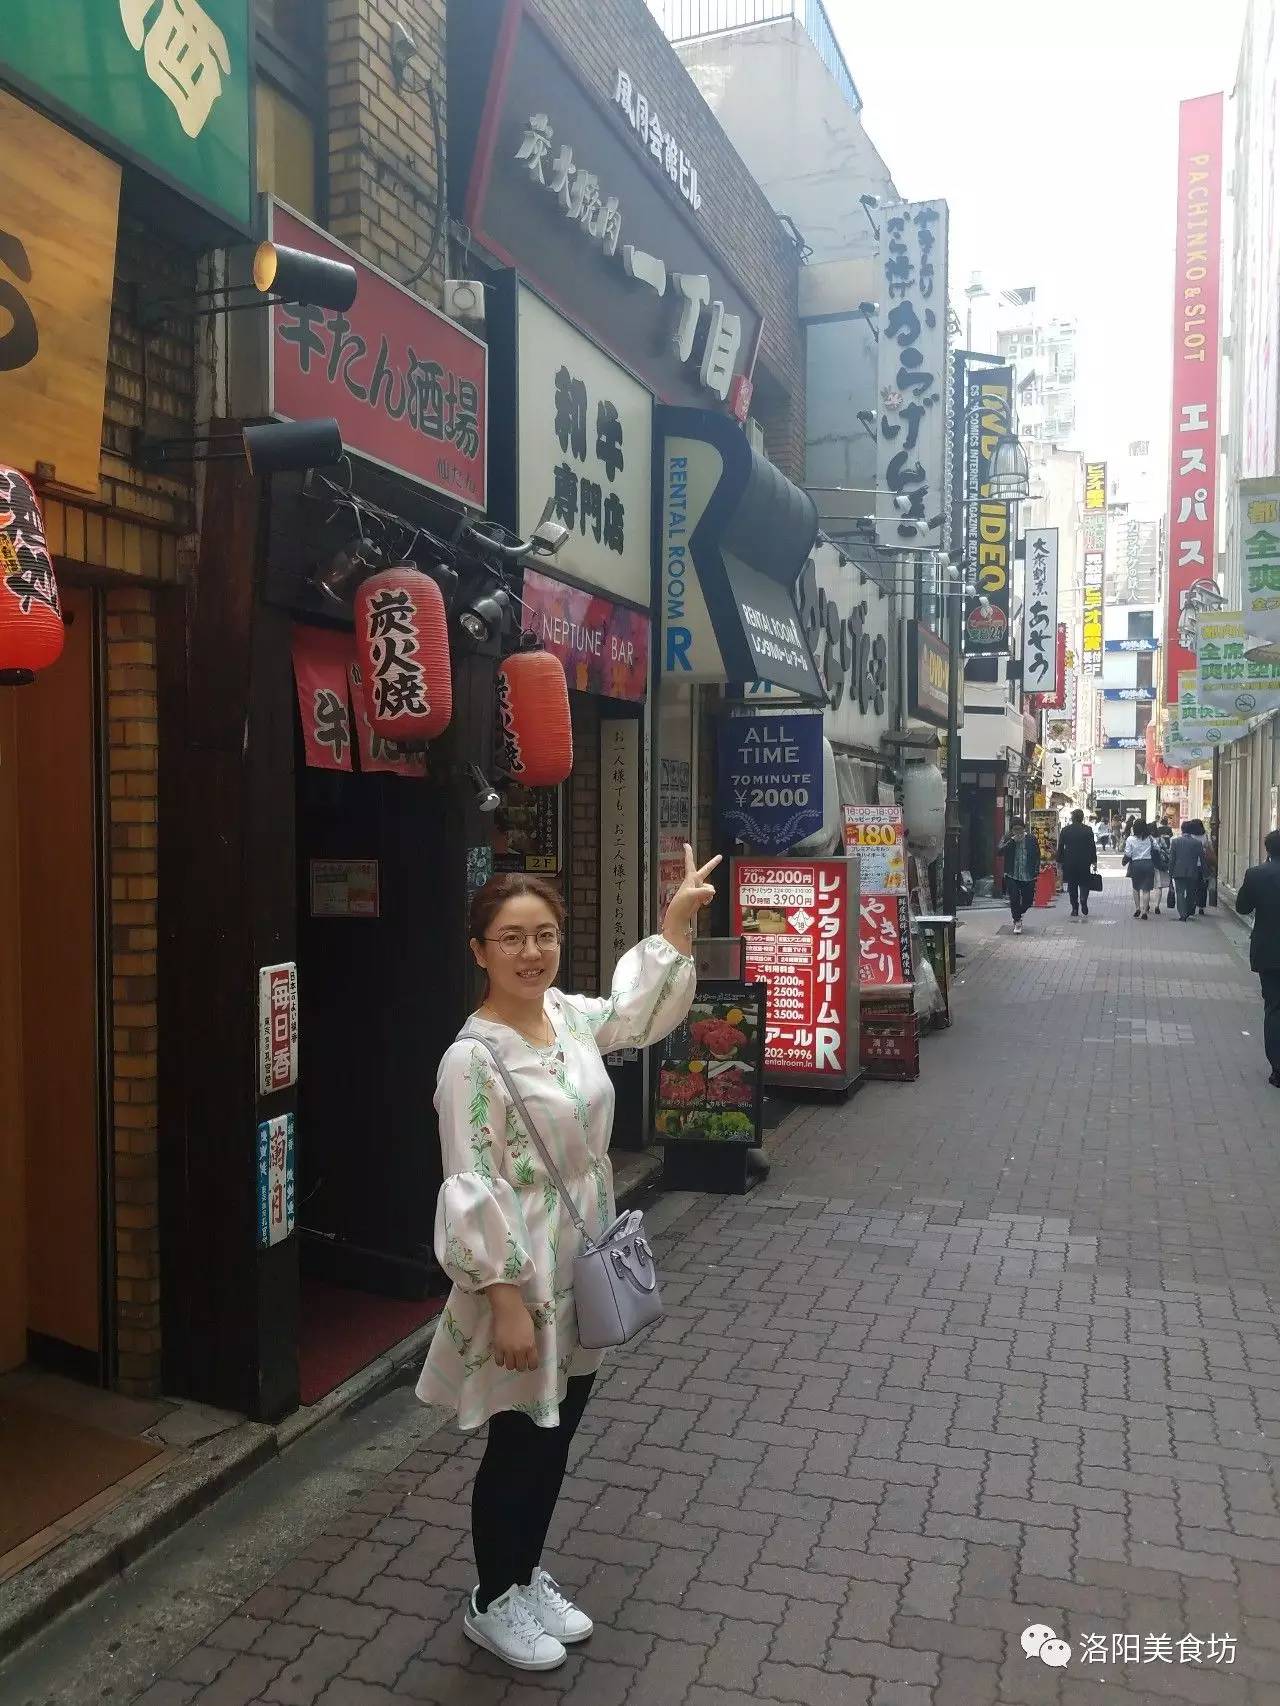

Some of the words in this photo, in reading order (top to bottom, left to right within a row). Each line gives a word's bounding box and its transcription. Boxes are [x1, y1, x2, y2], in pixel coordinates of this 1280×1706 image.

[1184, 153, 1210, 281] PACHINKO
[622, 244, 742, 401] 一丁目
[1183, 286, 1201, 299] &
[1183, 302, 1207, 363] SLOT
[277, 302, 481, 462] 牛たん酒場
[969, 412, 979, 447] COMICS
[667, 456, 688, 538] RENTAL
[968, 448, 979, 492] INTERNET
[1177, 404, 1210, 568] エスパス
[967, 493, 978, 538] MAGAZINE
[667, 545, 686, 620] ROOM
[366, 587, 431, 721] 炭火焼
[542, 616, 602, 656] NEPTUNE
[611, 635, 634, 666] BAR
[666, 626, 692, 672] R
[1027, 601, 1052, 685] あそう
[313, 688, 349, 763] 牛
[738, 746, 800, 763] TIME
[744, 726, 795, 743] ALL
[532, 858, 552, 868] 2F
[816, 870, 841, 1024] レンタルルーム
[859, 897, 898, 984] やきとり
[271, 977, 291, 1081] 毎日香
[815, 1026, 842, 1070] R
